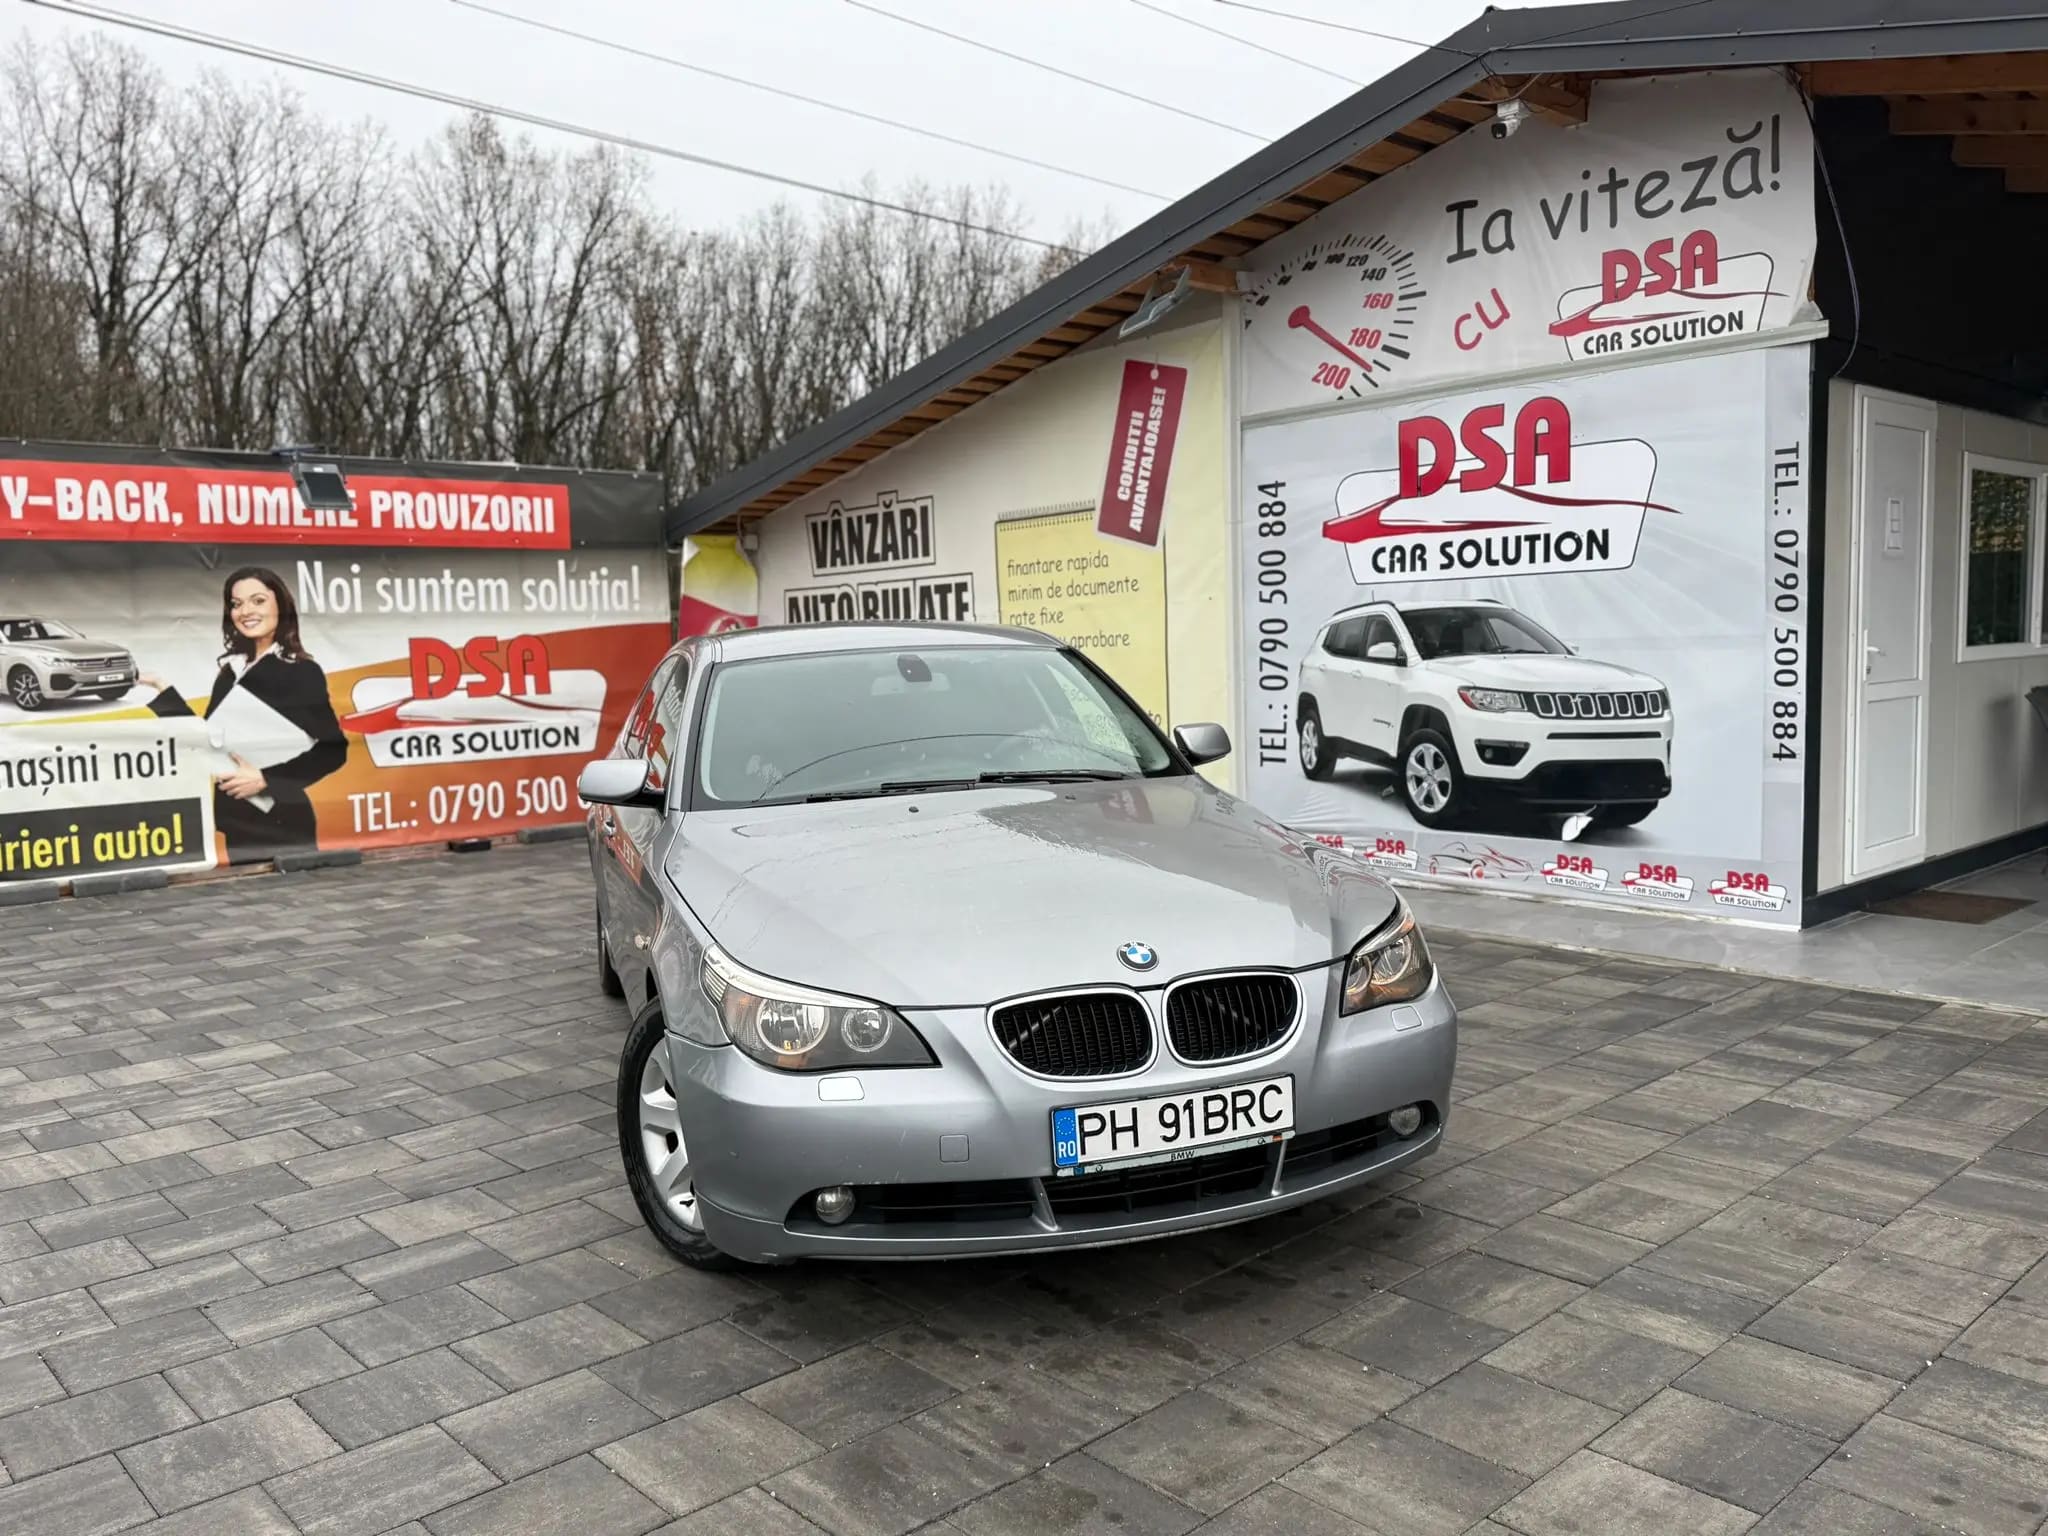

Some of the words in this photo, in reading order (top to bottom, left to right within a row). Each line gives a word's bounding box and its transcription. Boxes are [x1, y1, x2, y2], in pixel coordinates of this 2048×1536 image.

[1445, 199, 1515, 264] Ia
[1540, 113, 1780, 240] viteză!
[1346, 254, 1369, 267] 120
[1360, 267, 1387, 281] 140
[1601, 229, 1718, 305] DSA
[1362, 293, 1394, 309] 160
[1454, 287, 1511, 350] cu
[1348, 328, 1382, 349] 180
[1583, 333, 1623, 355] CAR
[1630, 310, 1744, 348] SOLUTION
[1312, 362, 1351, 390] 200
[1117, 410, 1145, 501] CONDITII
[1129, 387, 1166, 533] AVANTAJOASE!
[1398, 396, 1572, 499] DSA
[370, 490, 555, 533] PROVIZORII
[1257, 480, 1287, 538] 884
[810, 500, 930, 569] VÂNZĂRI
[1371, 543, 1427, 575] CAR
[1440, 528, 1611, 571] SOLUTION
[1007, 559, 1062, 577] finantare
[1067, 551, 1109, 575] rapida
[1258, 549, 1288, 605] 500
[1773, 529, 1799, 613] 0790
[297, 561, 362, 613] Noi
[376, 569, 509, 613] suntem
[1008, 584, 1042, 602] minim
[1047, 581, 1062, 598] de
[1066, 577, 1139, 597] documente
[1009, 611, 1036, 626] rate
[1040, 607, 1064, 624] fixe
[408, 634, 552, 700] DSA
[1259, 617, 1289, 692] 0790
[1773, 626, 1799, 688] 500
[390, 735, 441, 758] CAR
[453, 726, 580, 755] SOLUTION
[1772, 700, 1798, 762] 884
[114, 737, 178, 780] noi!
[348, 792, 418, 833] TEL.:
[429, 781, 504, 824] 0790
[516, 775, 568, 815] 500
[94, 812, 184, 862] auto!
[1376, 838, 1406, 855] DSA
[1550, 876, 1564, 885] CAR
[1565, 878, 1600, 890] SOLUTION
[1557, 854, 1593, 874] DSA
[1639, 863, 1677, 883] DSA
[1727, 871, 1769, 892] DSA
[1632, 887, 1646, 895] CAR
[1648, 888, 1686, 899] SOLUTION
[1720, 896, 1735, 904] CAR
[1737, 898, 1777, 909] SOLUTION
[1058, 1140, 1076, 1158] RO
[1078, 1107, 1139, 1156] PH
[1170, 1149, 1195, 1161] BMW
